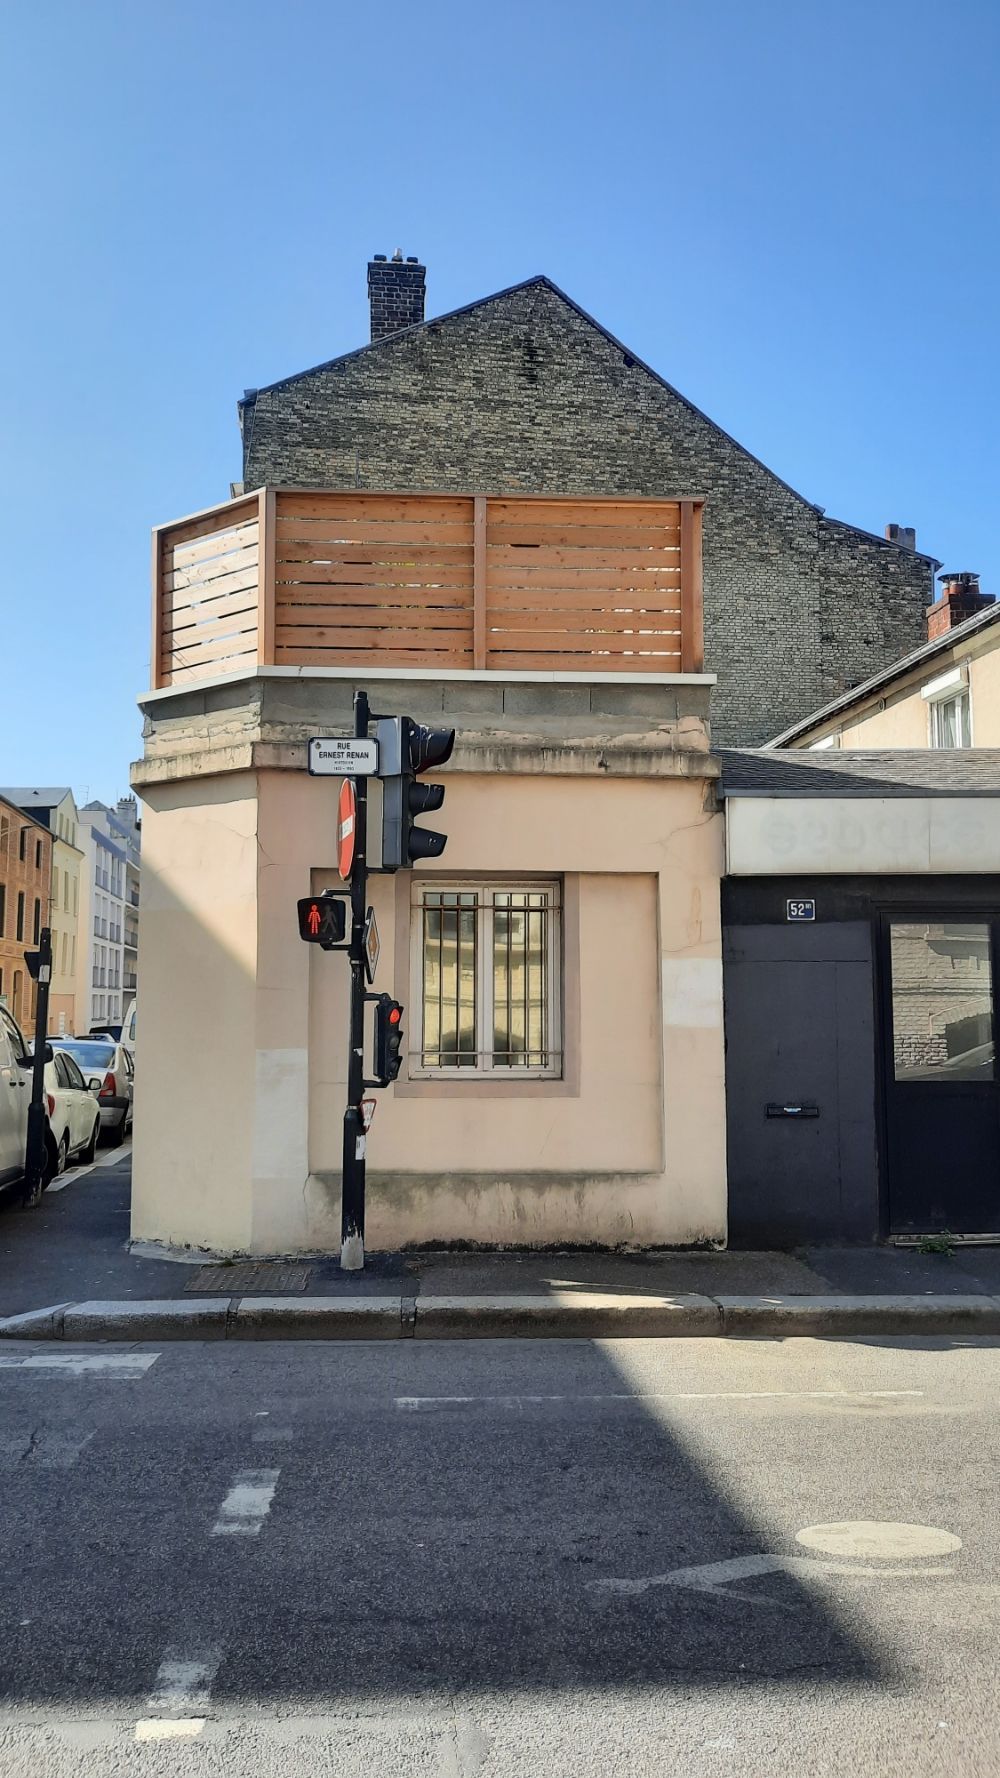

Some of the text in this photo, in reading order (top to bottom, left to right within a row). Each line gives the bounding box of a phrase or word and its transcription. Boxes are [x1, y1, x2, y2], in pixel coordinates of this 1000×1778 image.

[337, 742, 351, 750] RUE
[319, 751, 369, 759] ERNEST RENAN
[790, 903, 805, 916] 52
